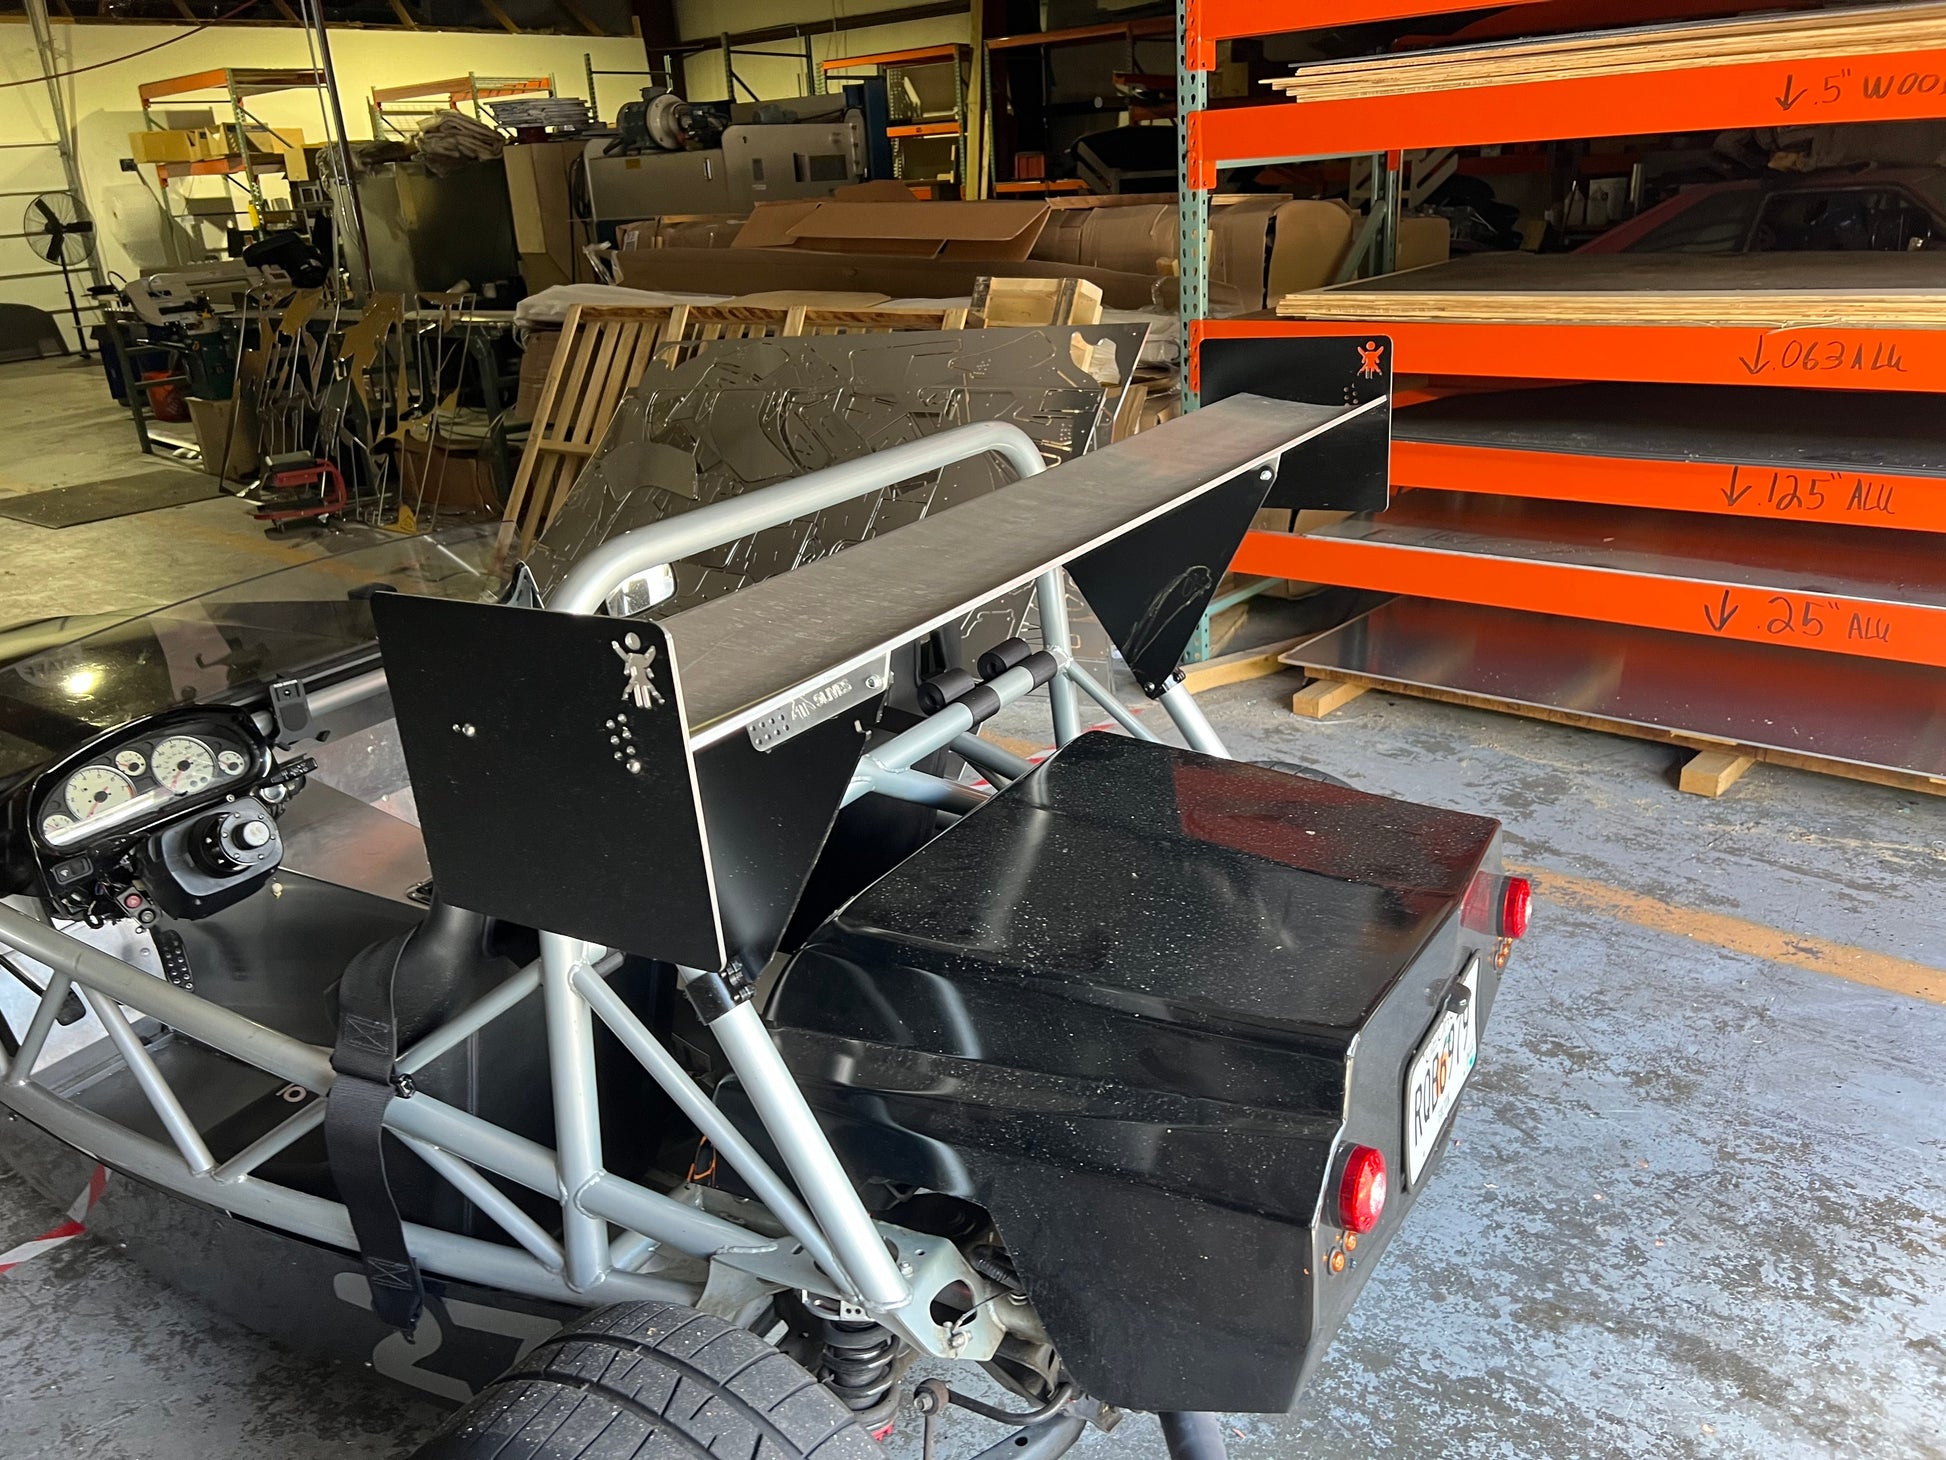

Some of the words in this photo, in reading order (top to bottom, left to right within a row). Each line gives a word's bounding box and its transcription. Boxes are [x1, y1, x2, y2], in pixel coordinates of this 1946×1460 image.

[1863, 72, 1946, 99] WOO
[1846, 478, 1896, 515] ALU
[1848, 612, 1890, 643] ALU
